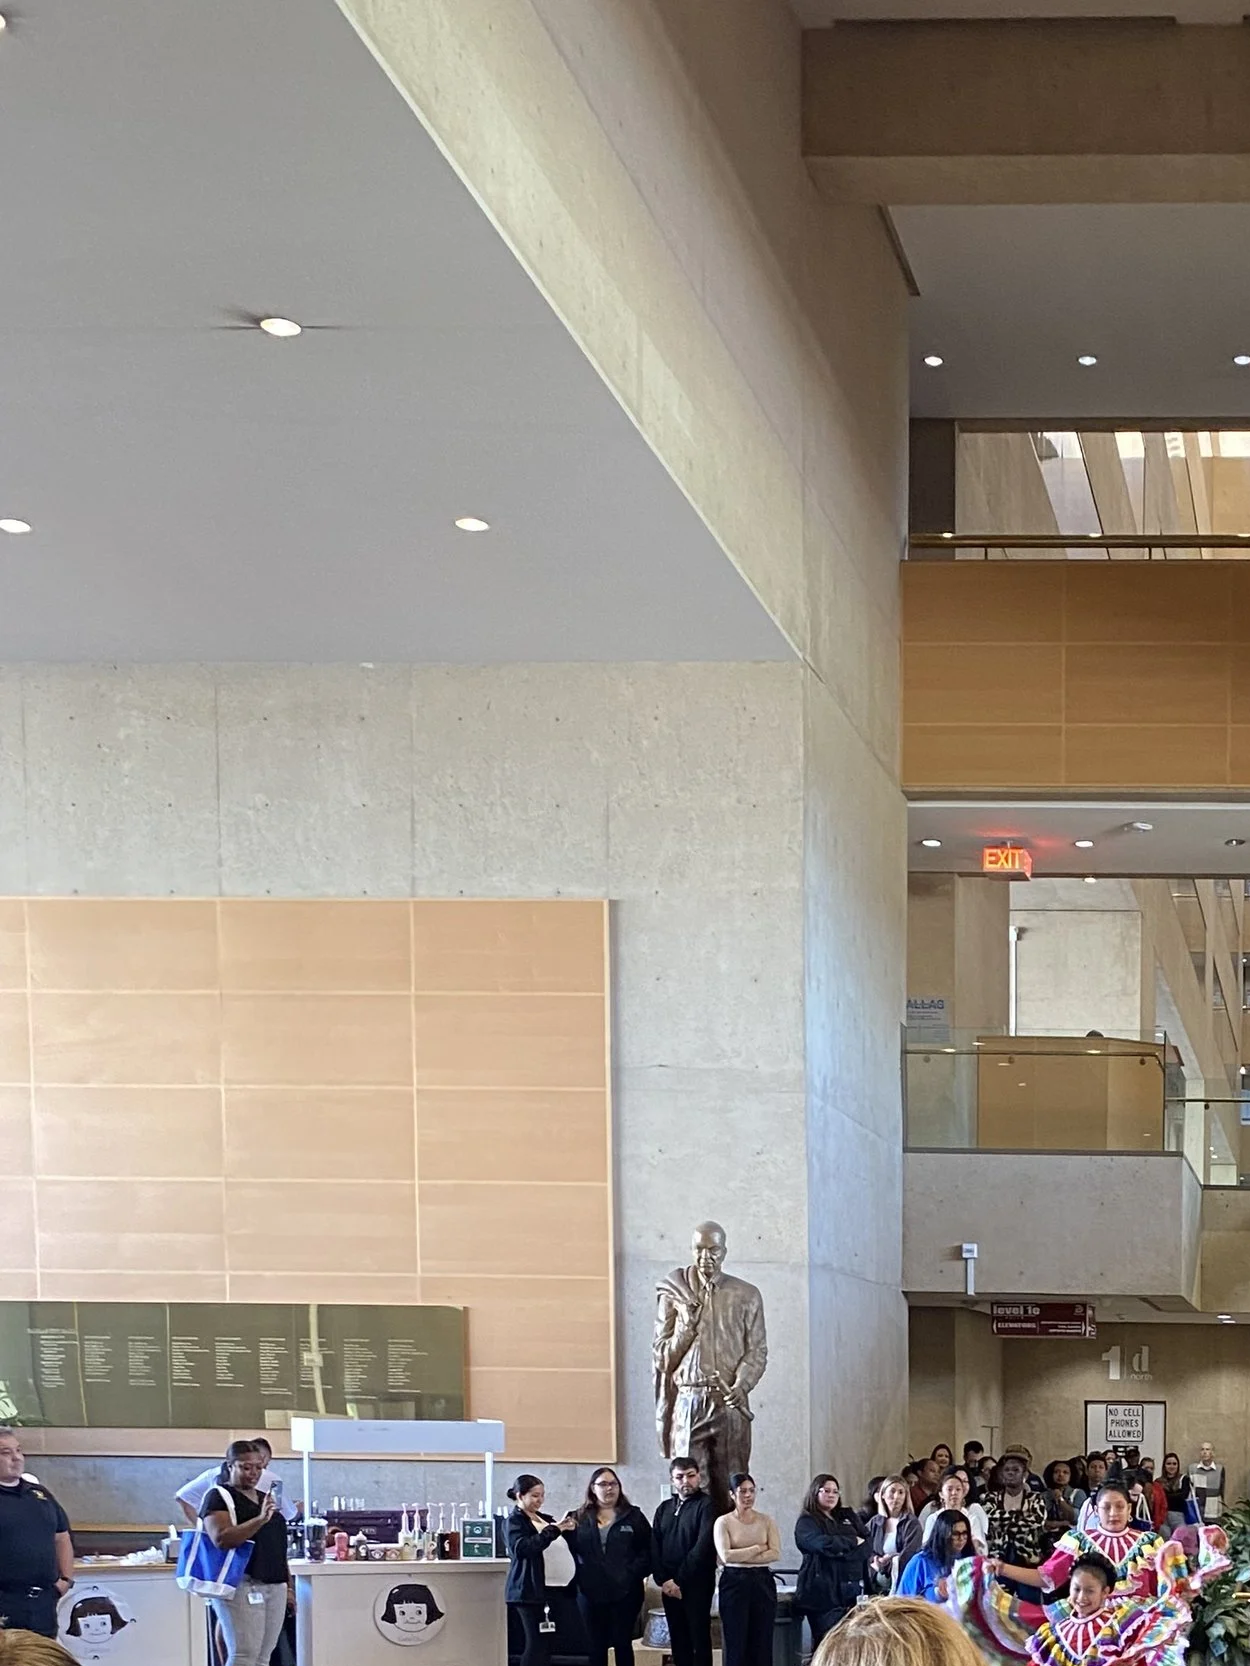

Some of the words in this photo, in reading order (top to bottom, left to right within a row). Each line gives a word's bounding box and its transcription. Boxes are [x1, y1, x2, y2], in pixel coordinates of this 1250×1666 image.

[984, 848, 1024, 869] EXIT
[907, 999, 944, 1009] ALLAS
[1108, 1408, 1119, 1416] NO
[1123, 1408, 1140, 1416] CELL
[1110, 1419, 1139, 1427] PHONES
[1108, 1430, 1141, 1438] ALLOWED
